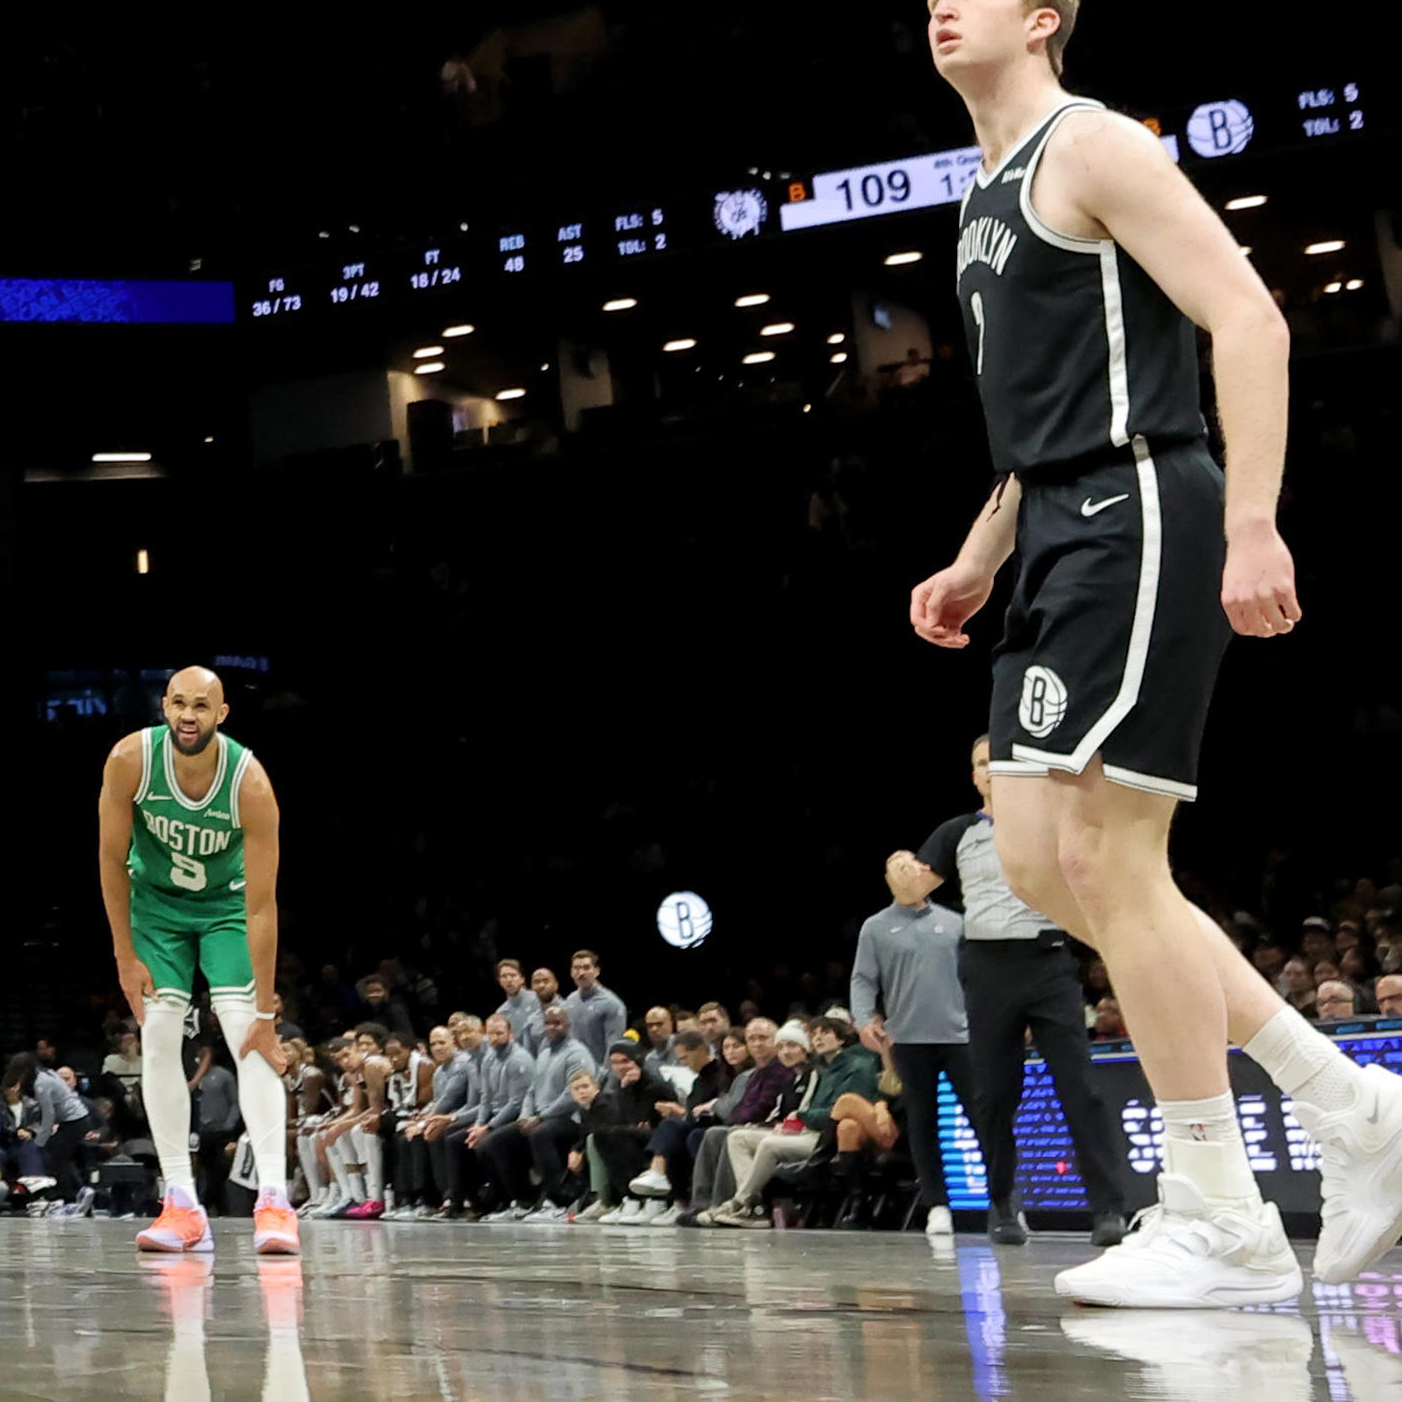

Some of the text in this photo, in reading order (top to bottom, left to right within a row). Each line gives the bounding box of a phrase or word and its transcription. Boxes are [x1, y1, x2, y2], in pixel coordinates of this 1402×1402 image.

[1349, 109, 1364, 129] 2
[836, 169, 912, 212] 109
[654, 232, 667, 250] 2
[424, 248, 441, 266] FT
[562, 245, 584, 264] 25
[142, 809, 232, 856] BOSTON
